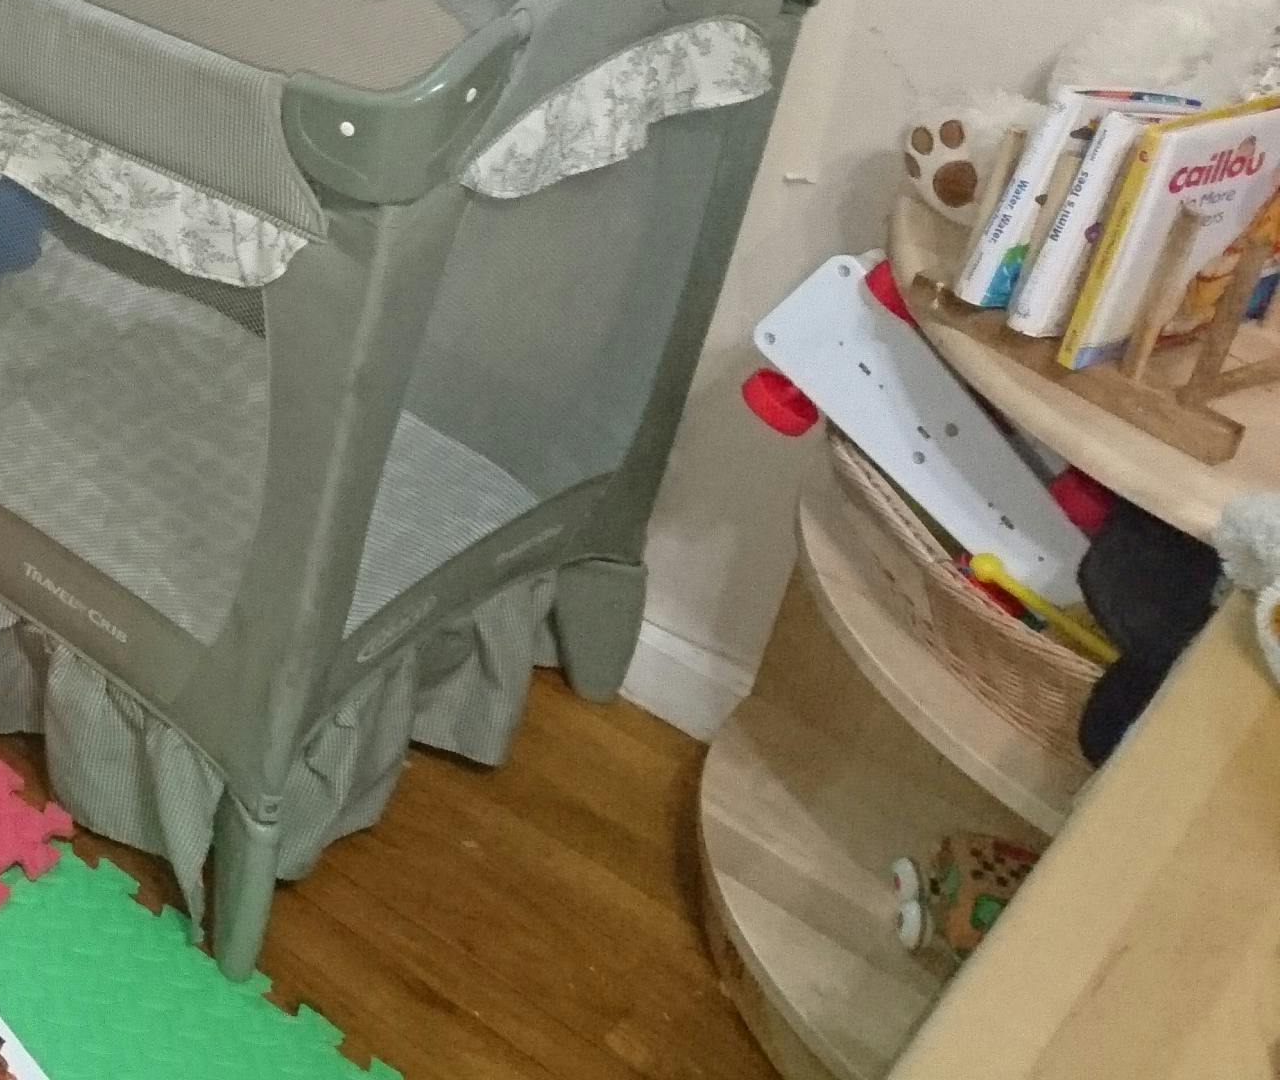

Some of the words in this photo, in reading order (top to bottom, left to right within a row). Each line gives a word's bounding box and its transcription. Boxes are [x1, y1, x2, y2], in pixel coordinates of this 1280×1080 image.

[1070, 171, 1089, 199] Toes
[1168, 149, 1265, 194] caillou
[87, 609, 129, 643] CRIB
